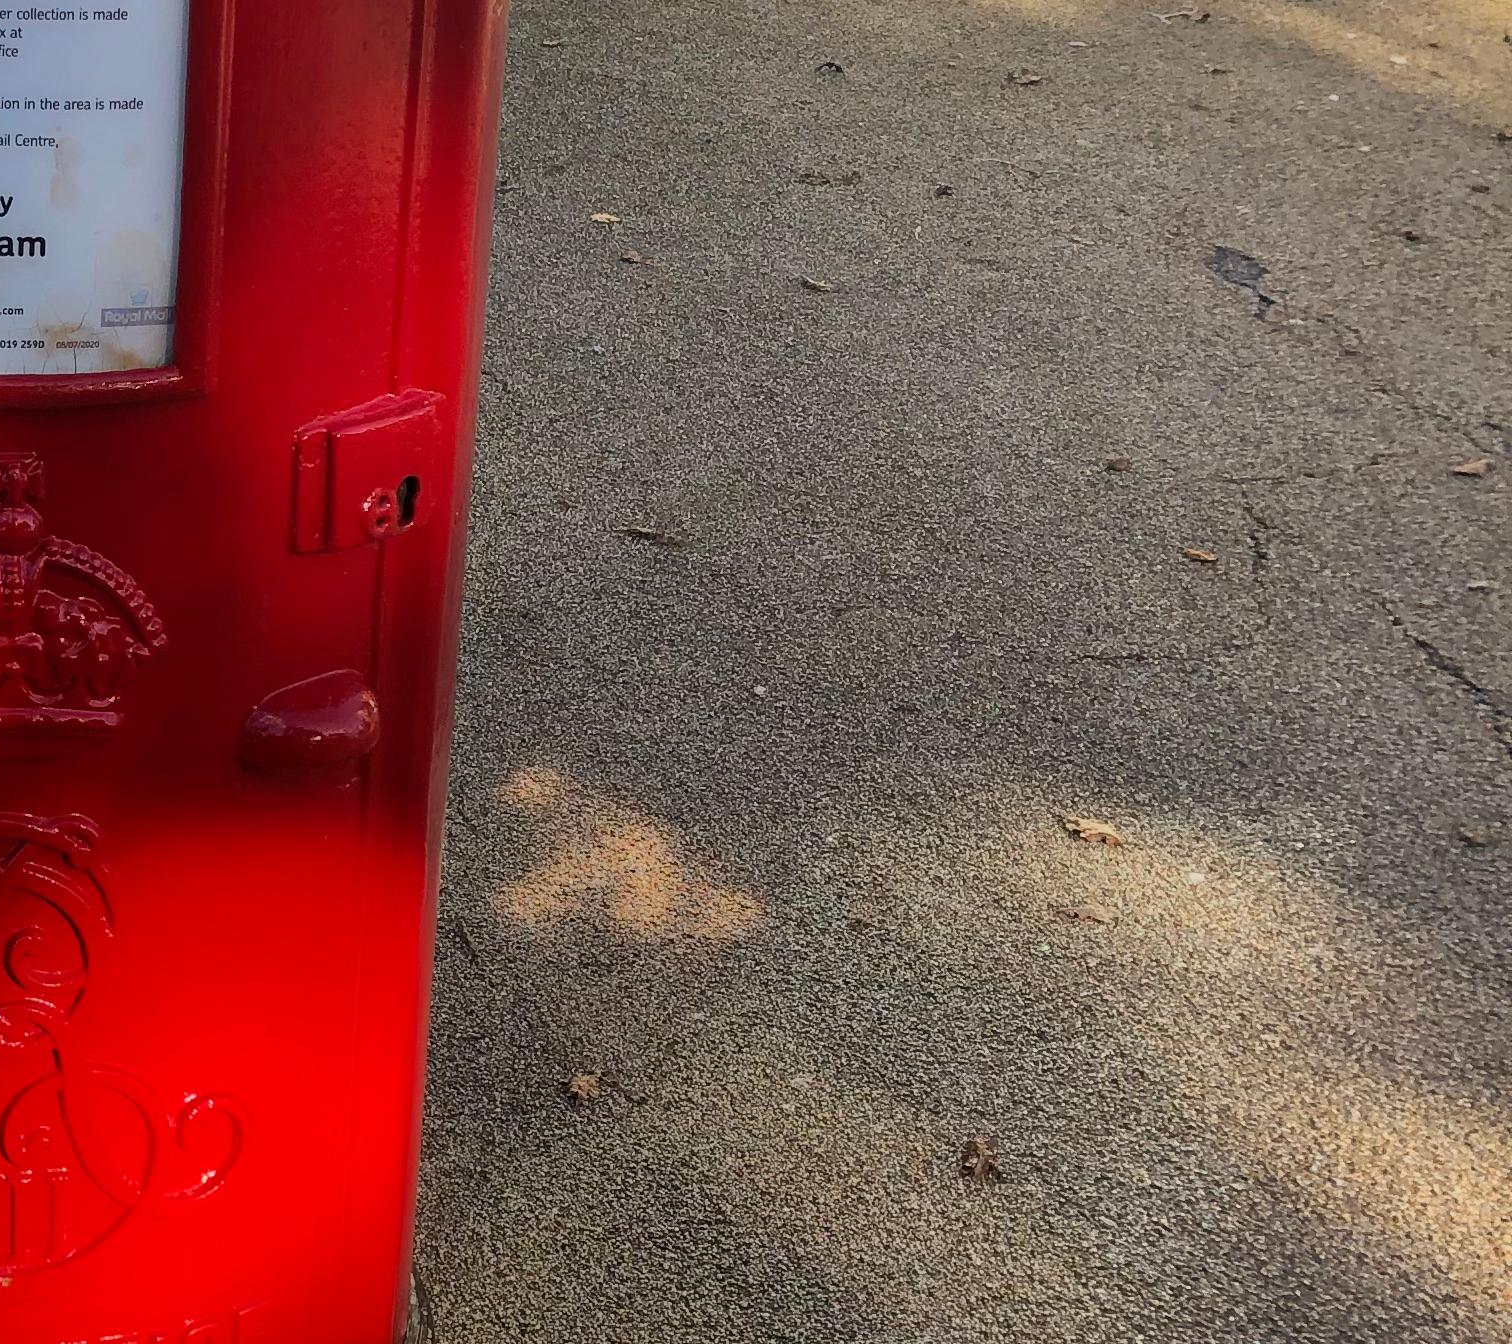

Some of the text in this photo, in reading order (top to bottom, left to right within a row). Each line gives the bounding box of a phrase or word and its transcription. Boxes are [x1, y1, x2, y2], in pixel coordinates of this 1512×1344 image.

[16, 8, 75, 21] collection
[79, 8, 89, 21] is
[93, 8, 128, 21] made
[10, 27, 24, 39] at
[25, 97, 36, 110] in
[40, 98, 60, 111] the
[64, 99, 92, 111] area
[95, 98, 105, 111] is
[109, 98, 144, 111] made
[15, 133, 59, 149] Centre,
[105, 309, 142, 325] Royal
